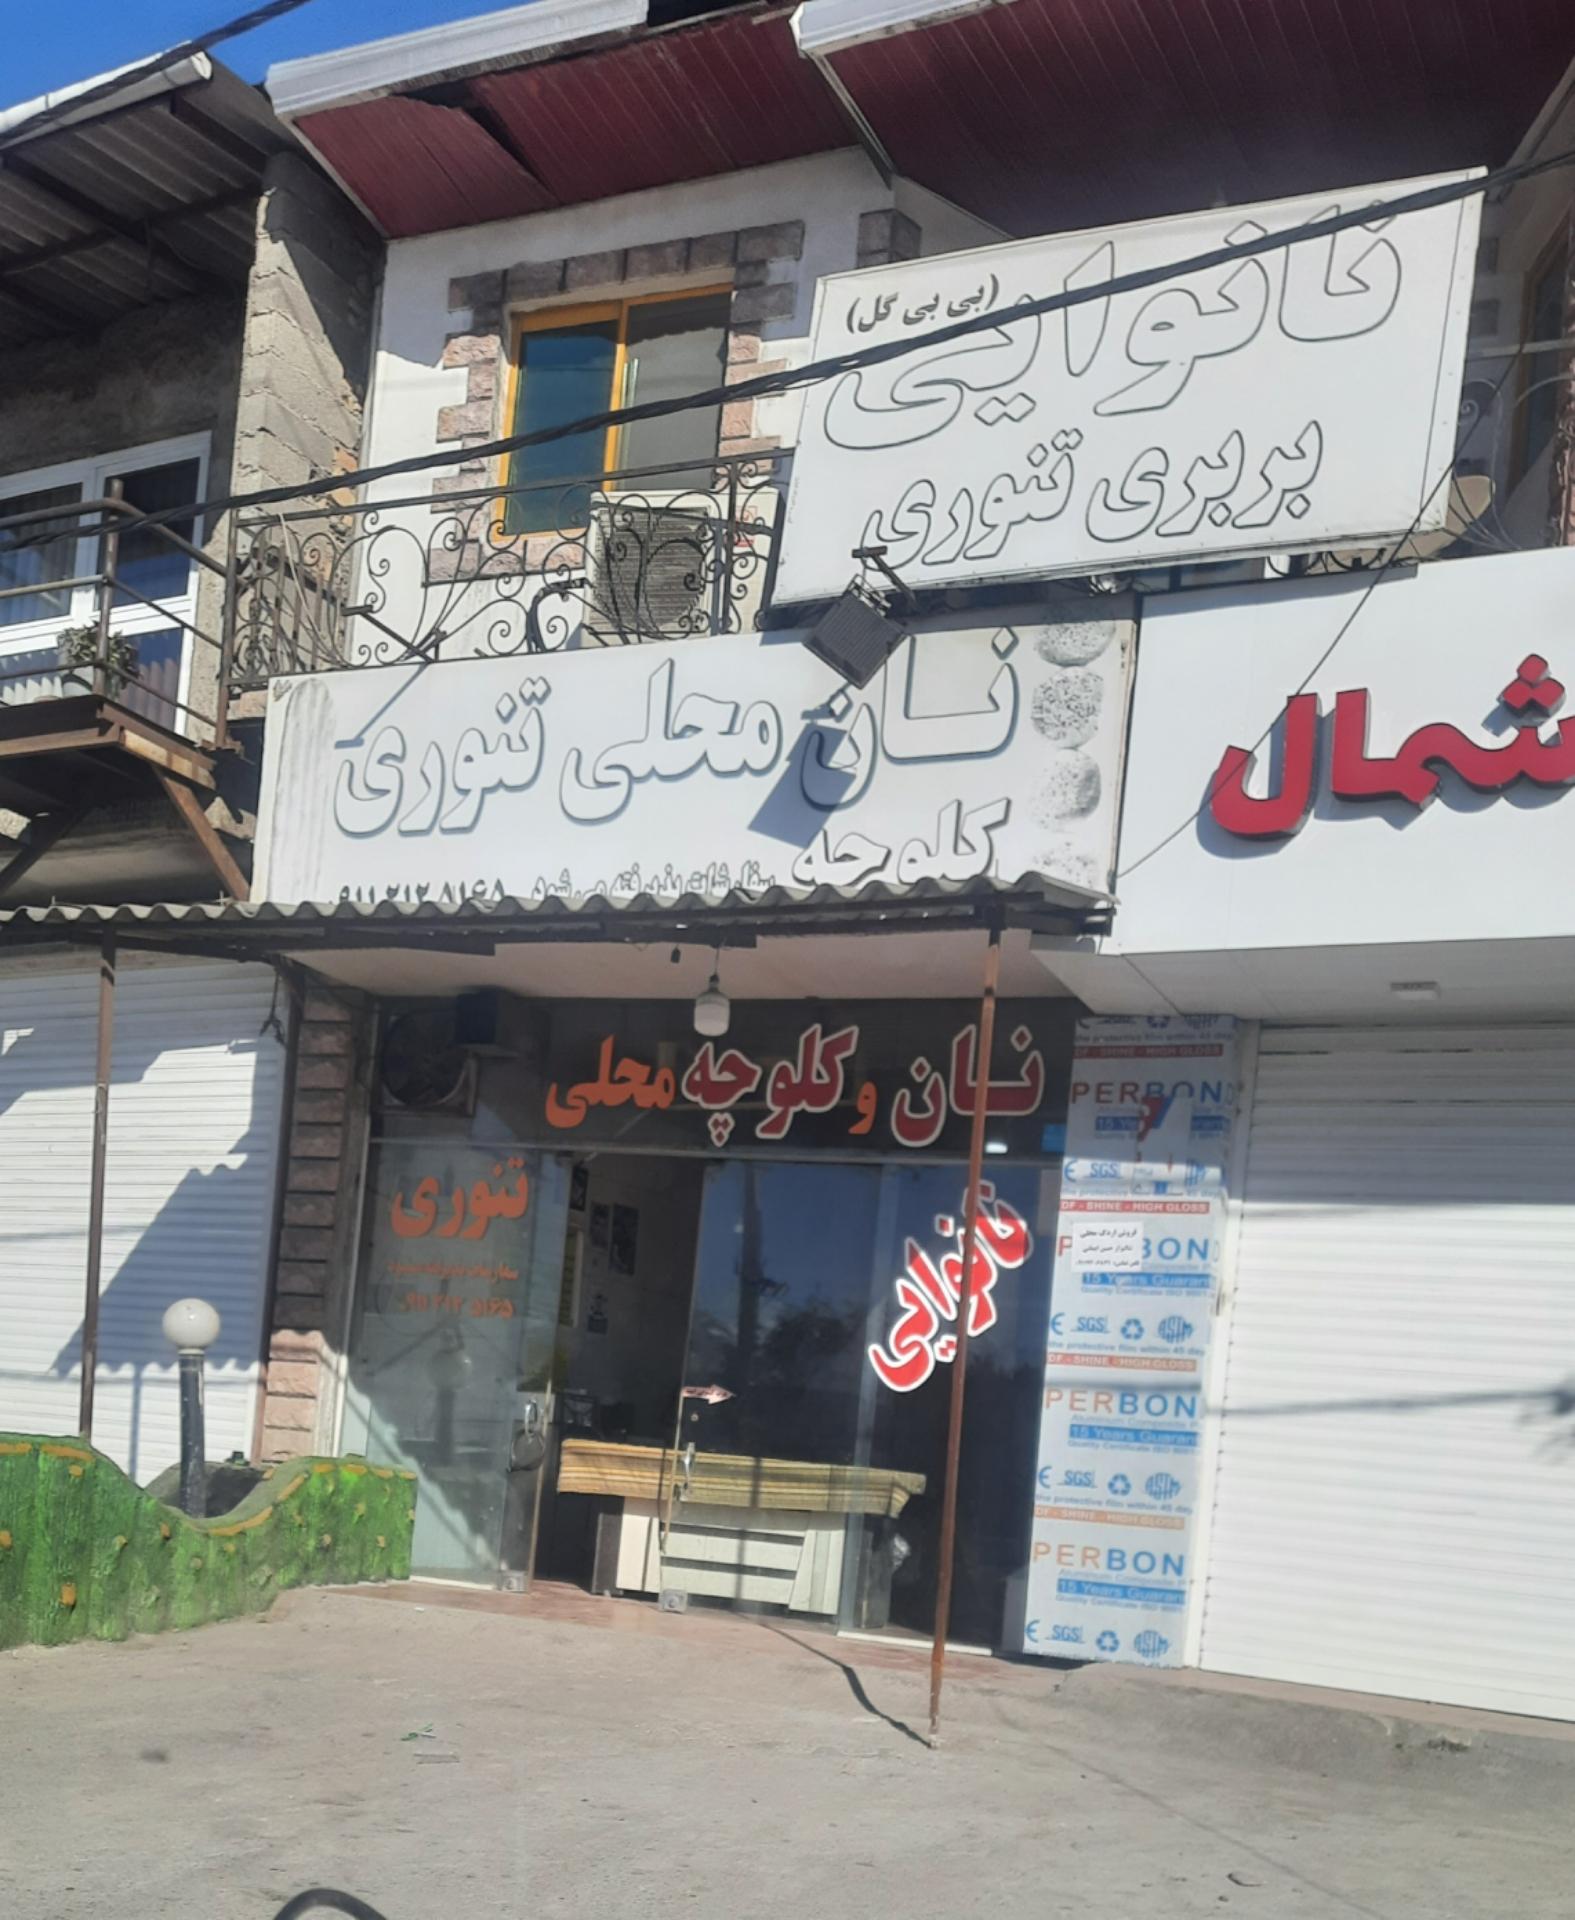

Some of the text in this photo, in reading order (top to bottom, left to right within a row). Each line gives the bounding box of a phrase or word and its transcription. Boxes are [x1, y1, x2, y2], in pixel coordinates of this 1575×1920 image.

[825, 200, 1401, 449] نانوایی
[861, 420, 1323, 570] بربری تنوری
[333, 625, 1019, 836] نان محلی تنوری
[1103, 1046, 1135, 1057] SHINE
[1146, 1045, 1176, 1056] HIGH
[1181, 1044, 1220, 1056] GLOSS
[545, 1023, 1045, 1148] نان و کلوچه محلی
[1072, 1080, 1222, 1105] PERBON
[1090, 1162, 1120, 1179] SGS
[390, 1157, 529, 1240] تنوری
[1086, 1202, 1122, 1212] SHINE
[1132, 1202, 1165, 1213] HIGH
[1166, 1202, 1207, 1214] GLOSS
[1058, 1235, 1209, 1261] PBON
[868, 1180, 1033, 1393] نانوایی
[1085, 1273, 1101, 1284] 15
[1107, 1274, 1147, 1286] Years
[1077, 1316, 1106, 1333] SGS
[1073, 1355, 1109, 1365] SHINE
[1119, 1357, 1151, 1368] HIGH
[1152, 1358, 1193, 1370] GLOSS
[1045, 1388, 1196, 1419] PERBON
[1072, 1426, 1090, 1437] 15
[1095, 1427, 1135, 1441] Years
[1064, 1469, 1093, 1487] SGS
[1060, 1508, 1095, 1520] SHINE
[1106, 1512, 1138, 1524] HIGH
[1139, 1515, 1181, 1528] GLOSS
[1033, 1542, 1184, 1577] PERBON
[1060, 1580, 1077, 1591] 15
[1083, 1581, 1122, 1597] Years
[1052, 1624, 1079, 1642] SGS
